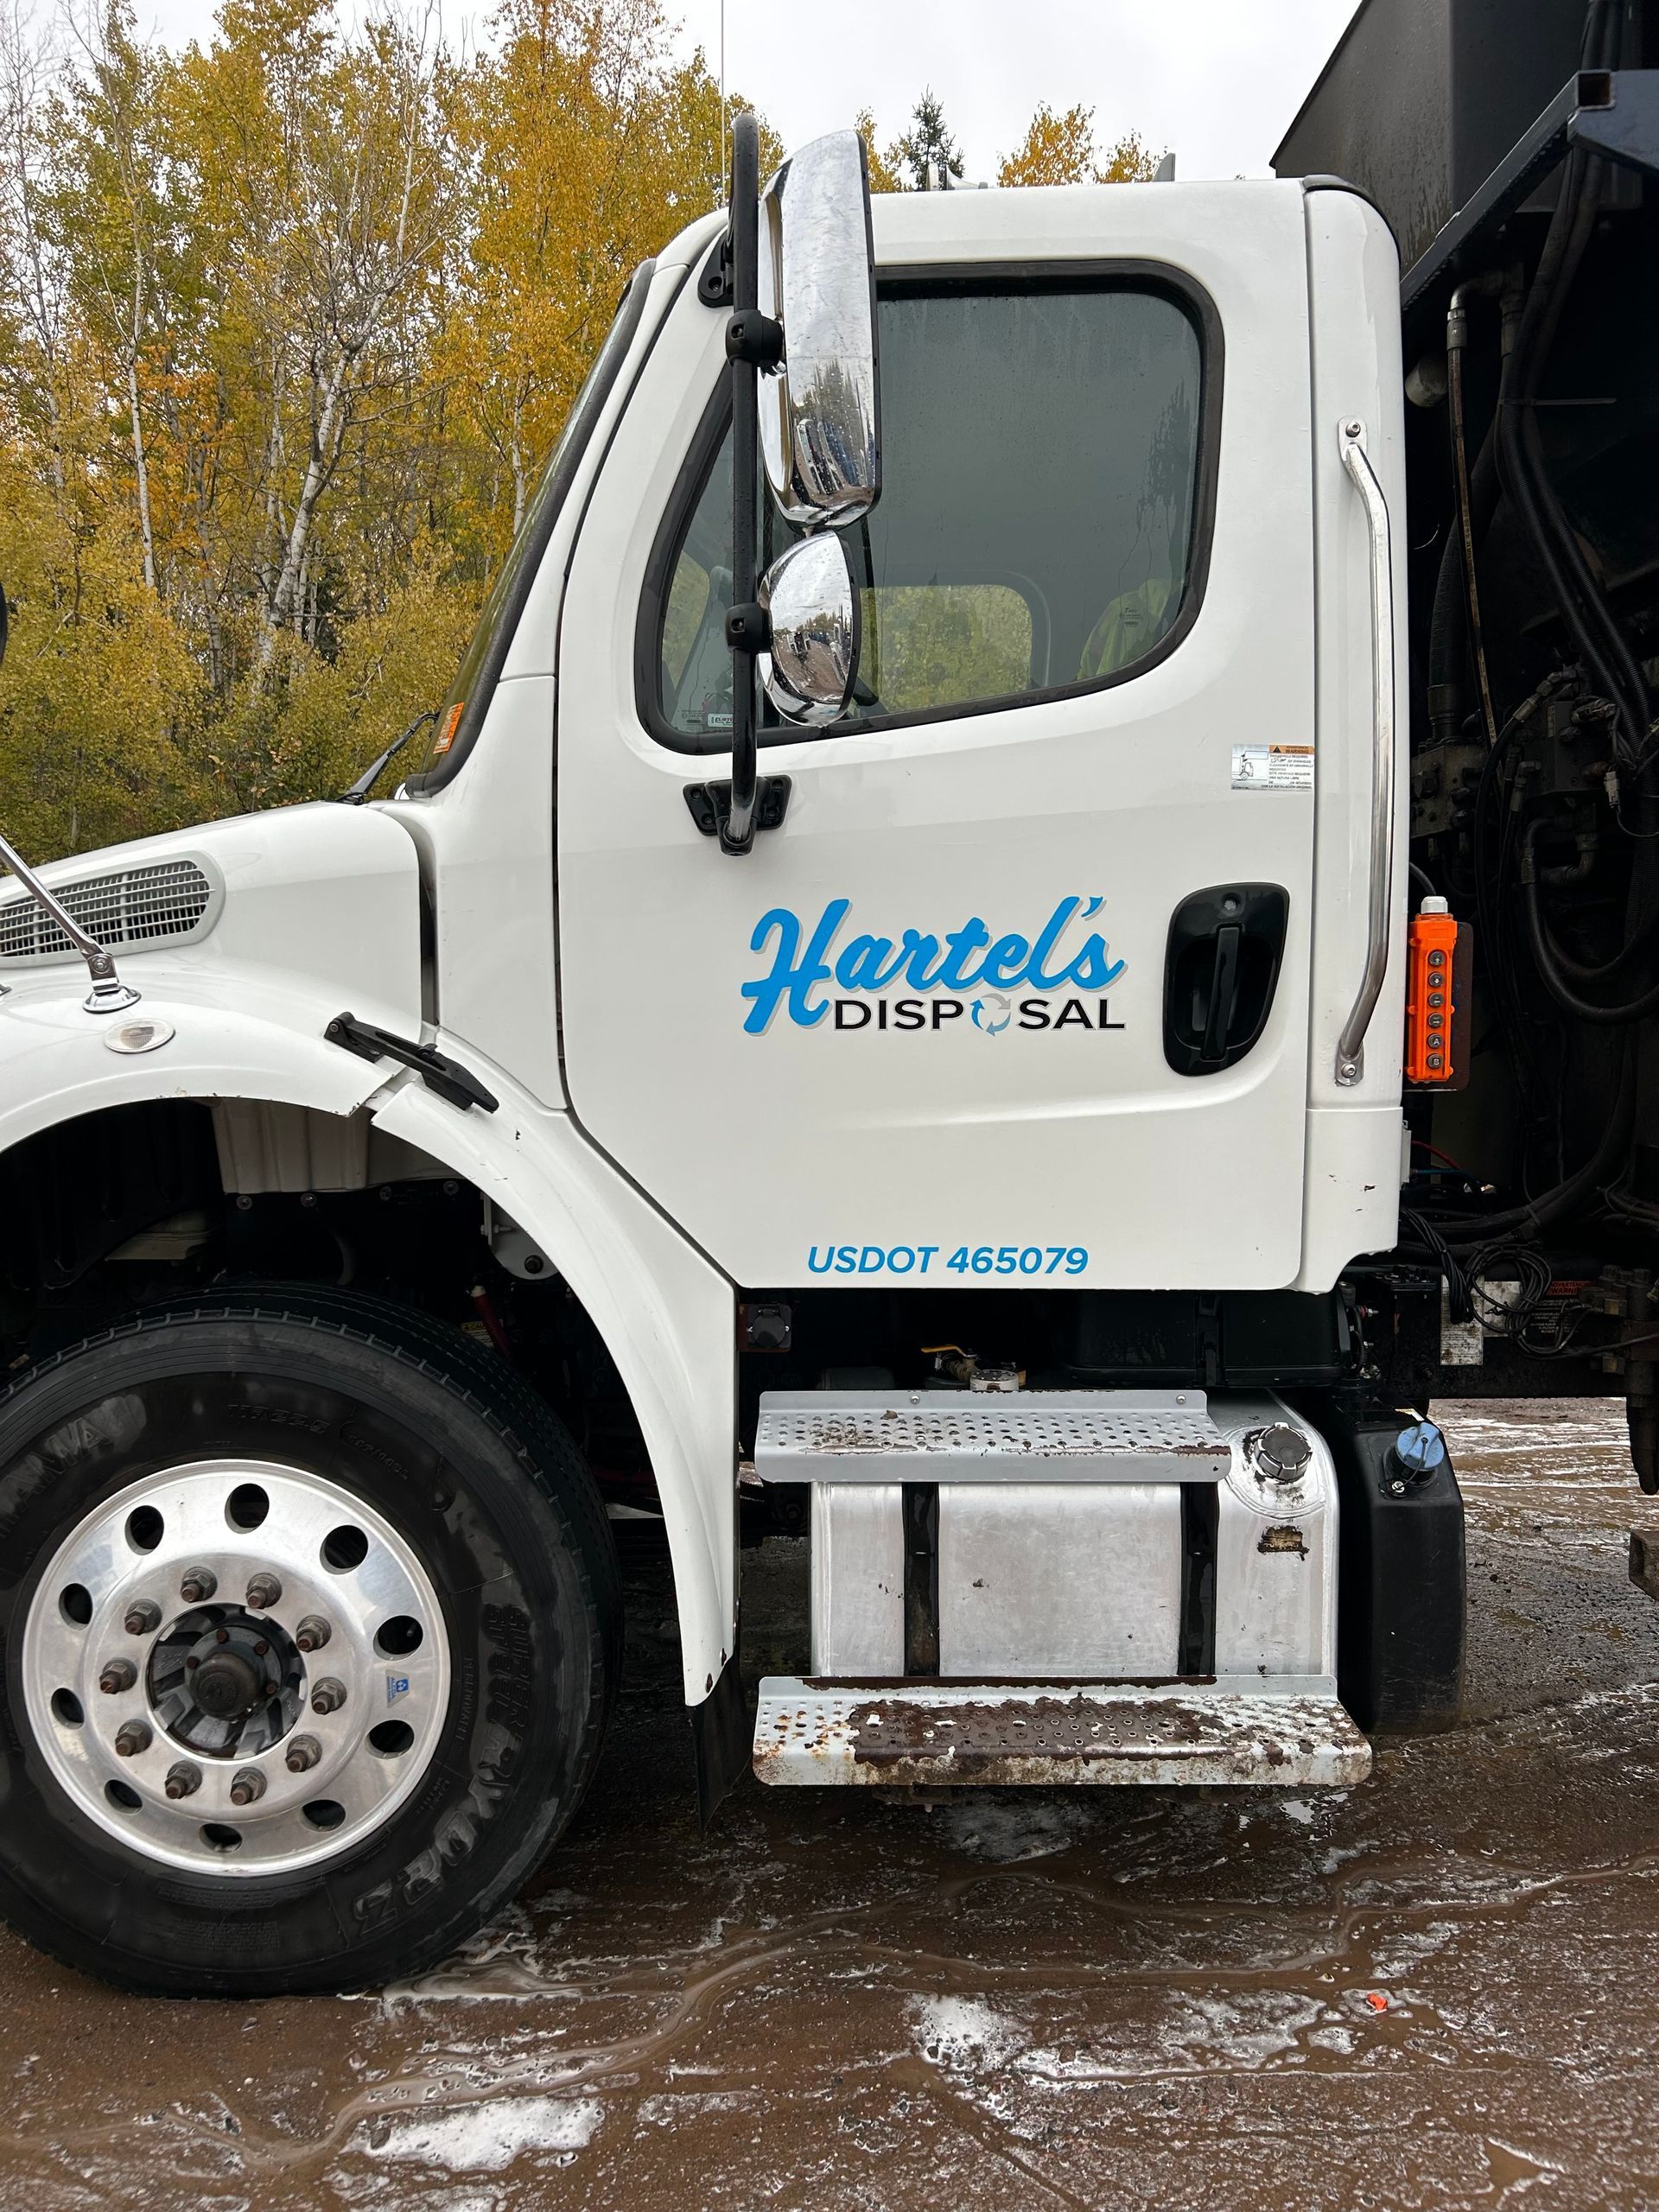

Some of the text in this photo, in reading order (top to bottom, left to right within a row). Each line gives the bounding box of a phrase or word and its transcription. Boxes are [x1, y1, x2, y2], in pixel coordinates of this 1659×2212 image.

[741, 895, 1129, 1036] Hartel's
[807, 1246, 1090, 1275] USDOT 465079
